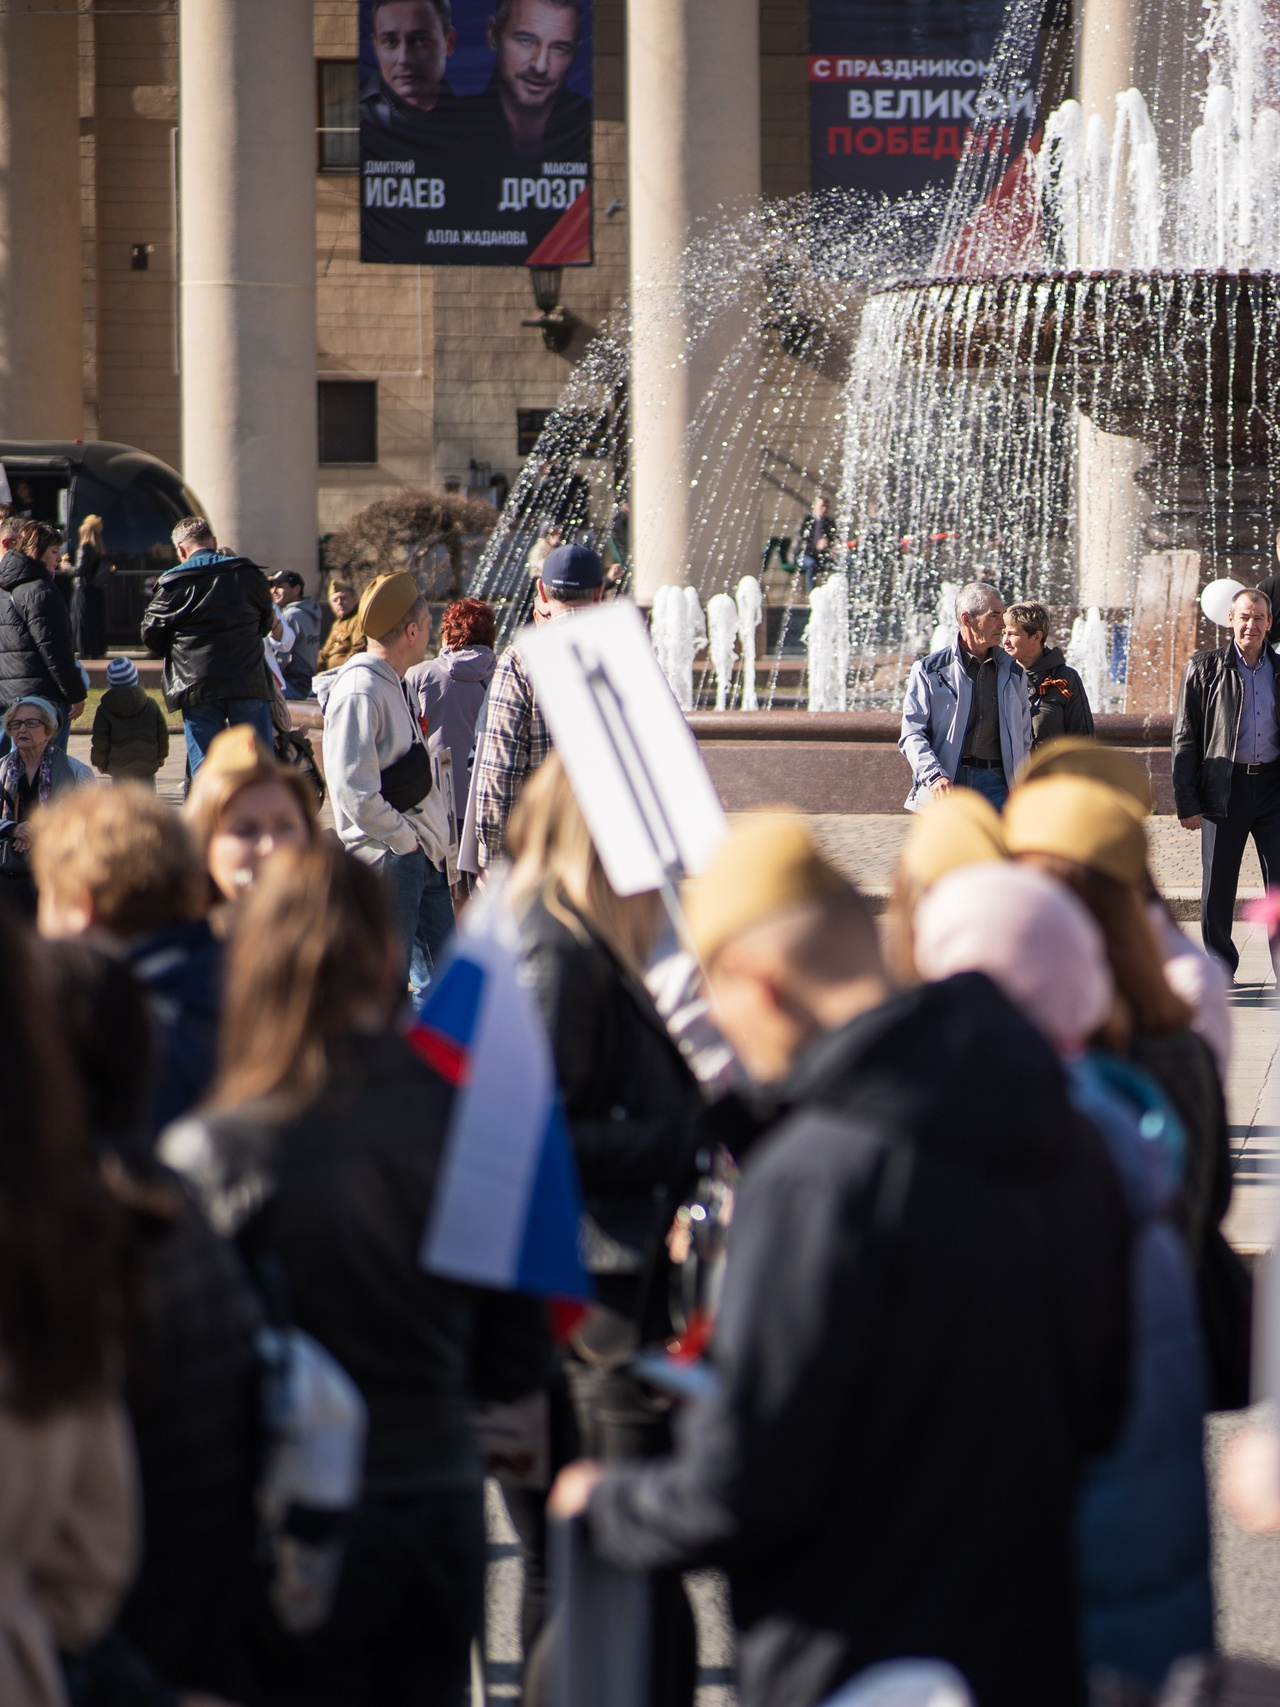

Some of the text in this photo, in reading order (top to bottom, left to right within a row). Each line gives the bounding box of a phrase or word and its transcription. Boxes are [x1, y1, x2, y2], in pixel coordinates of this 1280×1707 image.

[812, 59, 831, 77] С
[848, 79, 1035, 120] ВЕЛИКОЙ
[365, 159, 415, 175] ДМИТРИЙ
[542, 162, 588, 175] МАКСИМ
[365, 177, 446, 209] ИСАЕВ
[426, 230, 528, 246] АЛЛА ЖАДАНОВА
